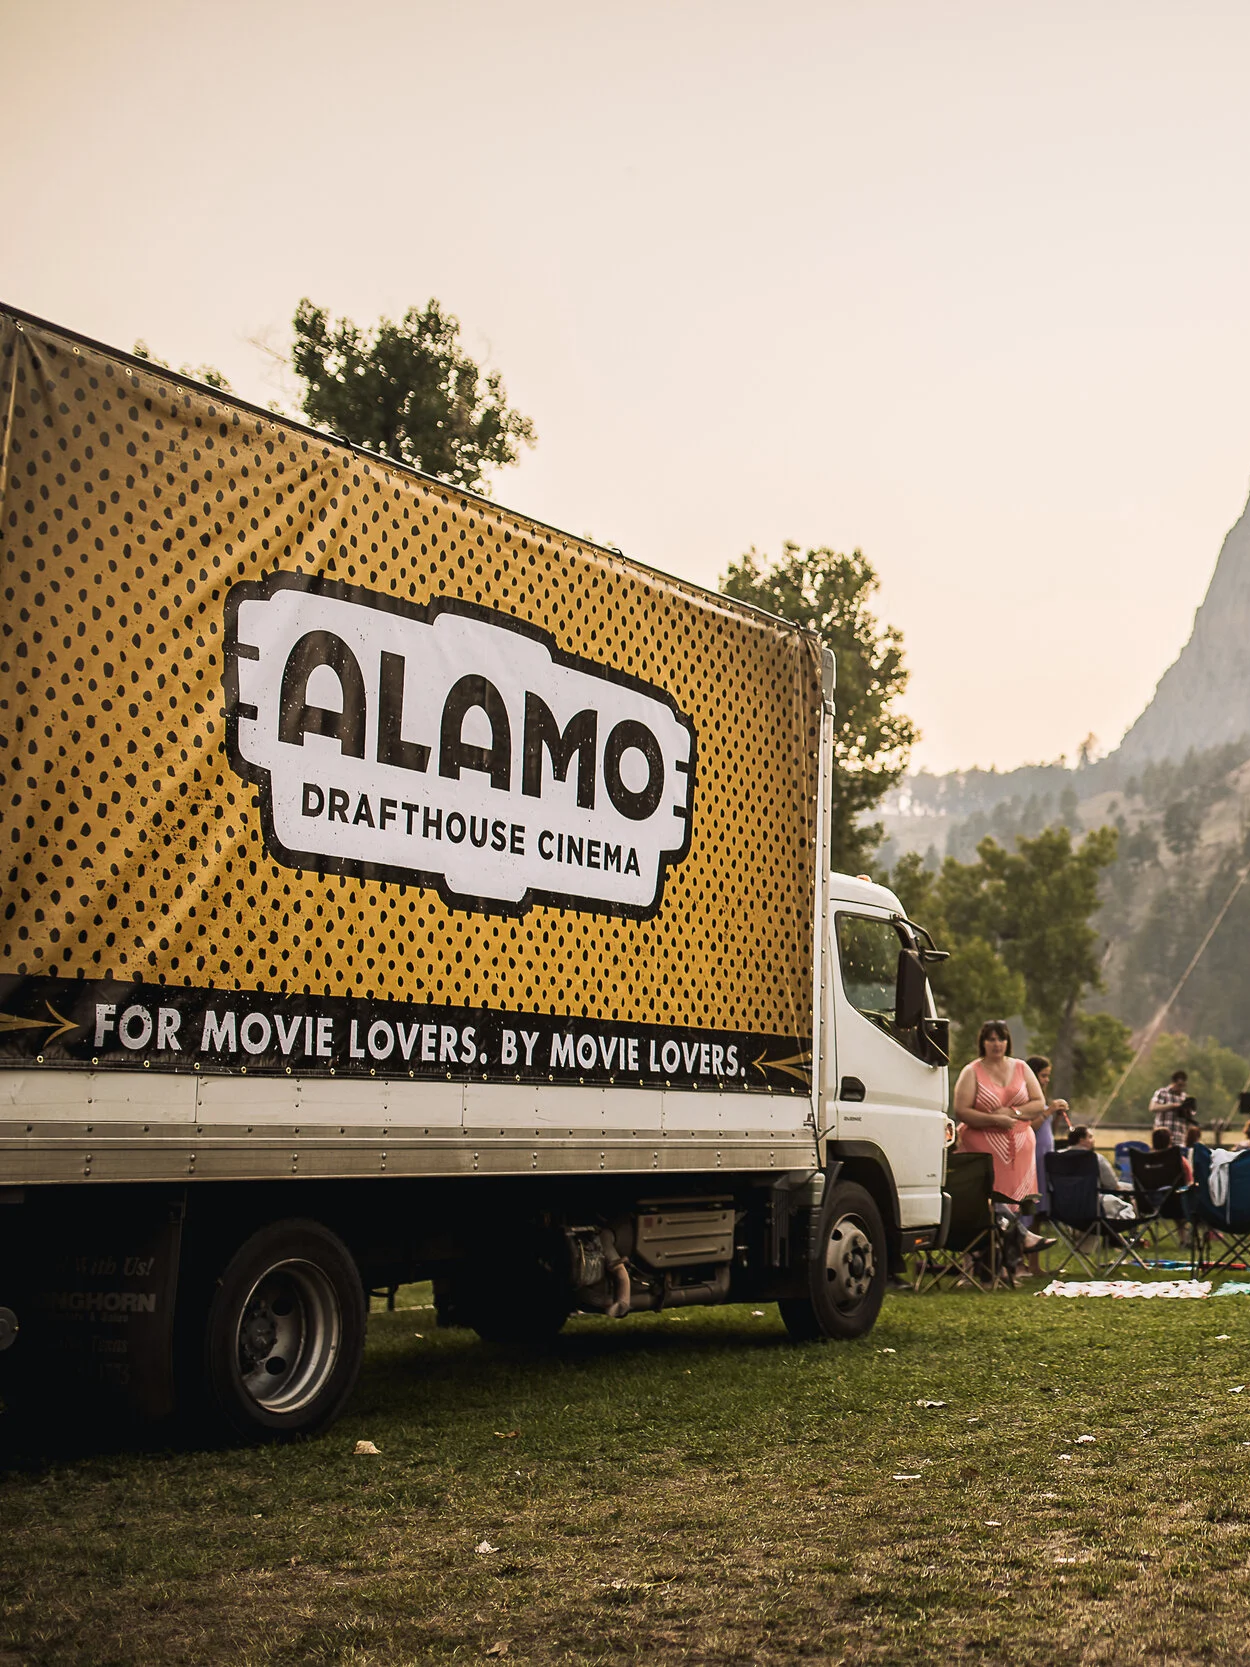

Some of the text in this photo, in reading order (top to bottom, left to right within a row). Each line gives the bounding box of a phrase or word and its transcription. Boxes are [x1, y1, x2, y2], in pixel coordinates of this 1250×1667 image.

[278, 630, 664, 821] ALAMO
[302, 783, 641, 876] DRAFTHOUSE CINEMA
[94, 1004, 745, 1077] FOR MOVIE LOVERS. BY MOVIE LOVERS.
[36, 1291, 157, 1313] NGHORN
[123, 1256, 155, 1276] Us!
